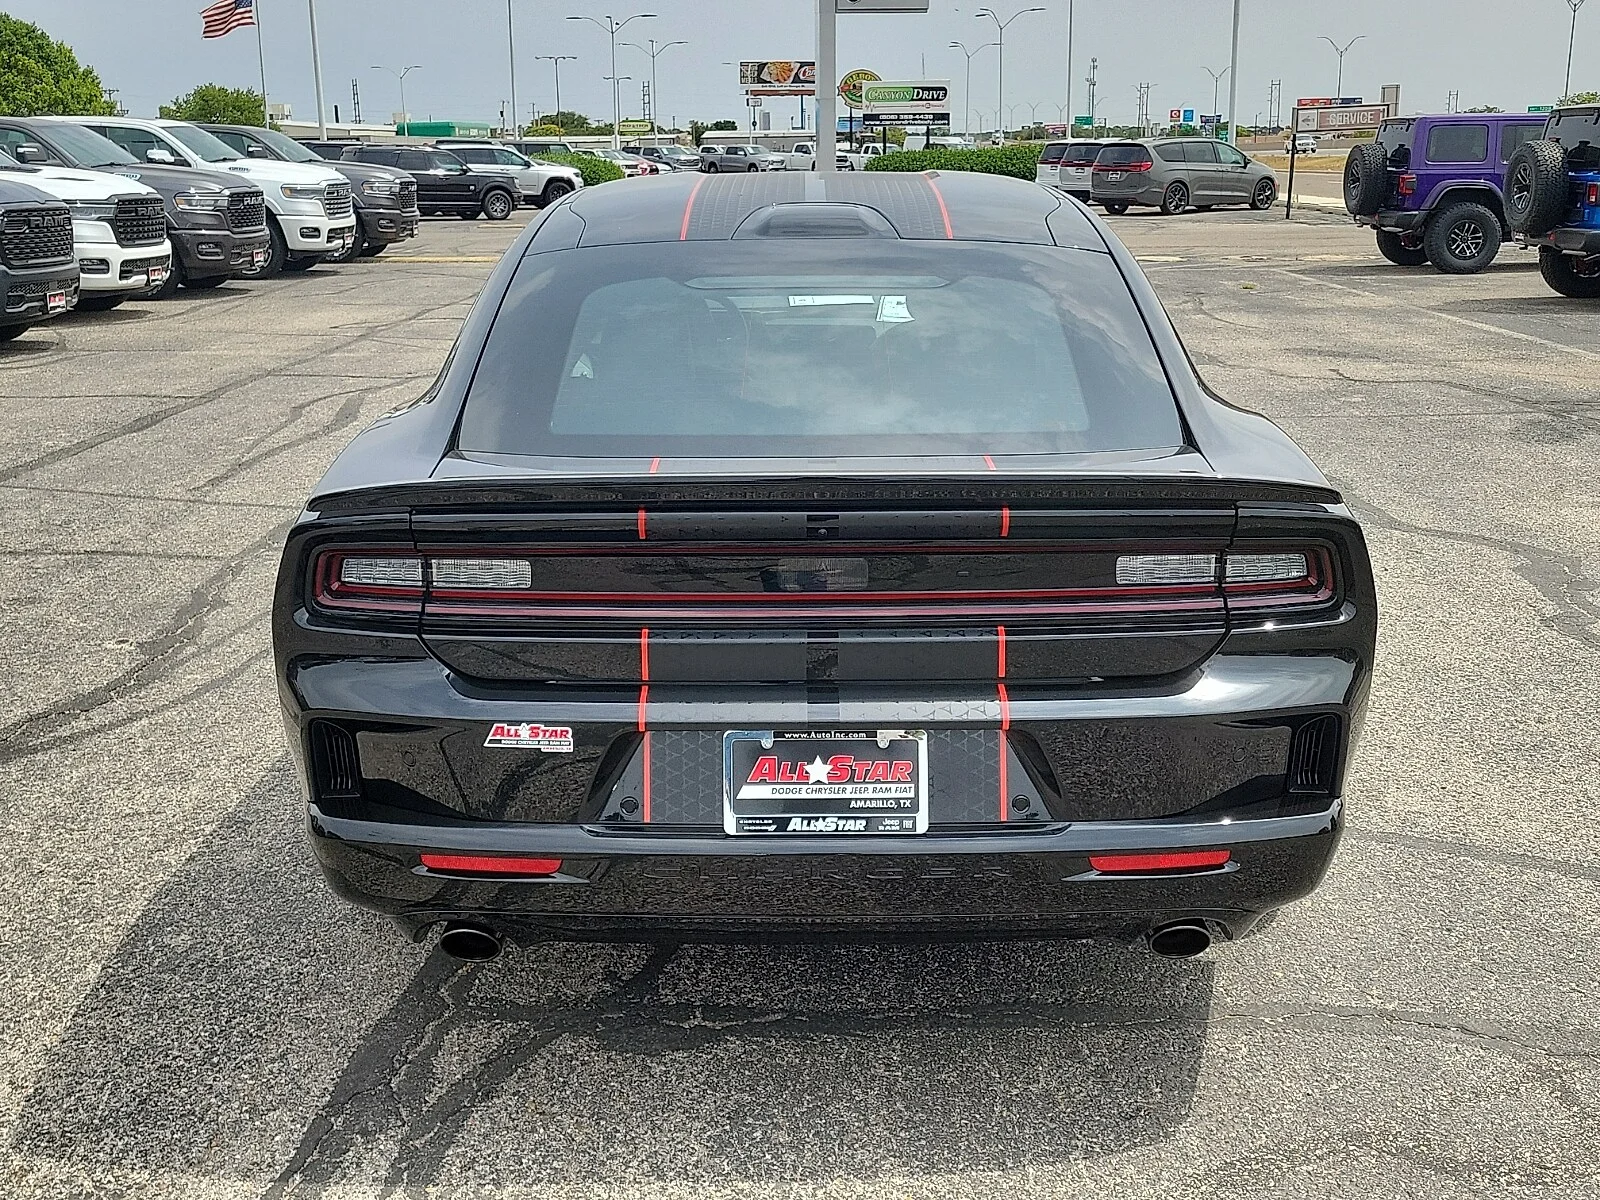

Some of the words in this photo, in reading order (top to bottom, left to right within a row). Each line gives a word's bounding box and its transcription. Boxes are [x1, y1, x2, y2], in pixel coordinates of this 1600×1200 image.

[913, 88, 945, 100] DRIVE
[1329, 112, 1375, 126] SERVICE
[136, 206, 165, 217] RAM
[29, 216, 64, 229] RAM
[784, 731, 867, 739] www.AutoInc.com
[771, 786, 803, 795] DODGE
[805, 786, 847, 795] CHRYSLER
[872, 786, 892, 794] RAM
[894, 786, 913, 794] FIAT
[849, 799, 898, 810] AMARILLO,
[899, 799, 912, 809] TX
